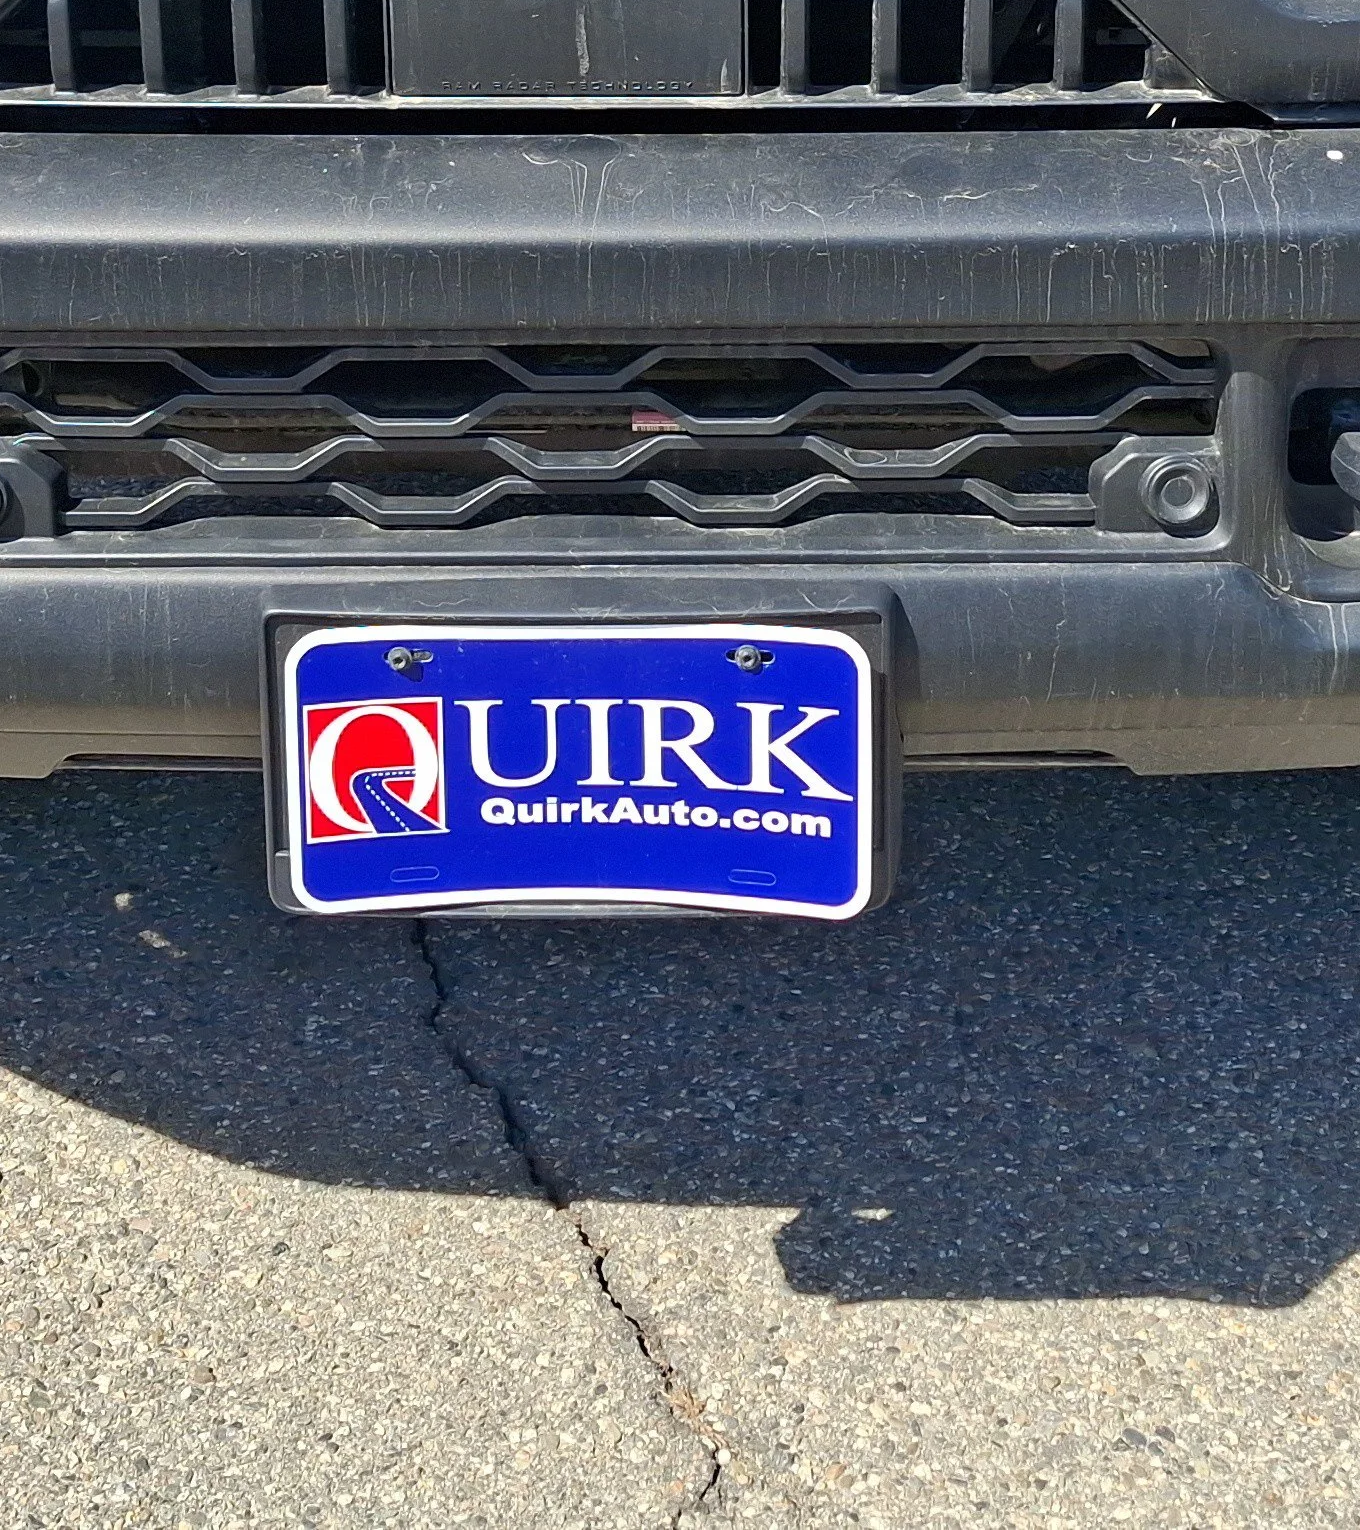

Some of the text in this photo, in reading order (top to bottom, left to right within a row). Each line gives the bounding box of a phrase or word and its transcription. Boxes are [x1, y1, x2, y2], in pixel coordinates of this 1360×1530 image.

[441, 81, 693, 92] RAM RADAR TECHNOLOGY
[308, 696, 854, 834] QUIRK
[480, 797, 832, 839] QuirkAuto.com
